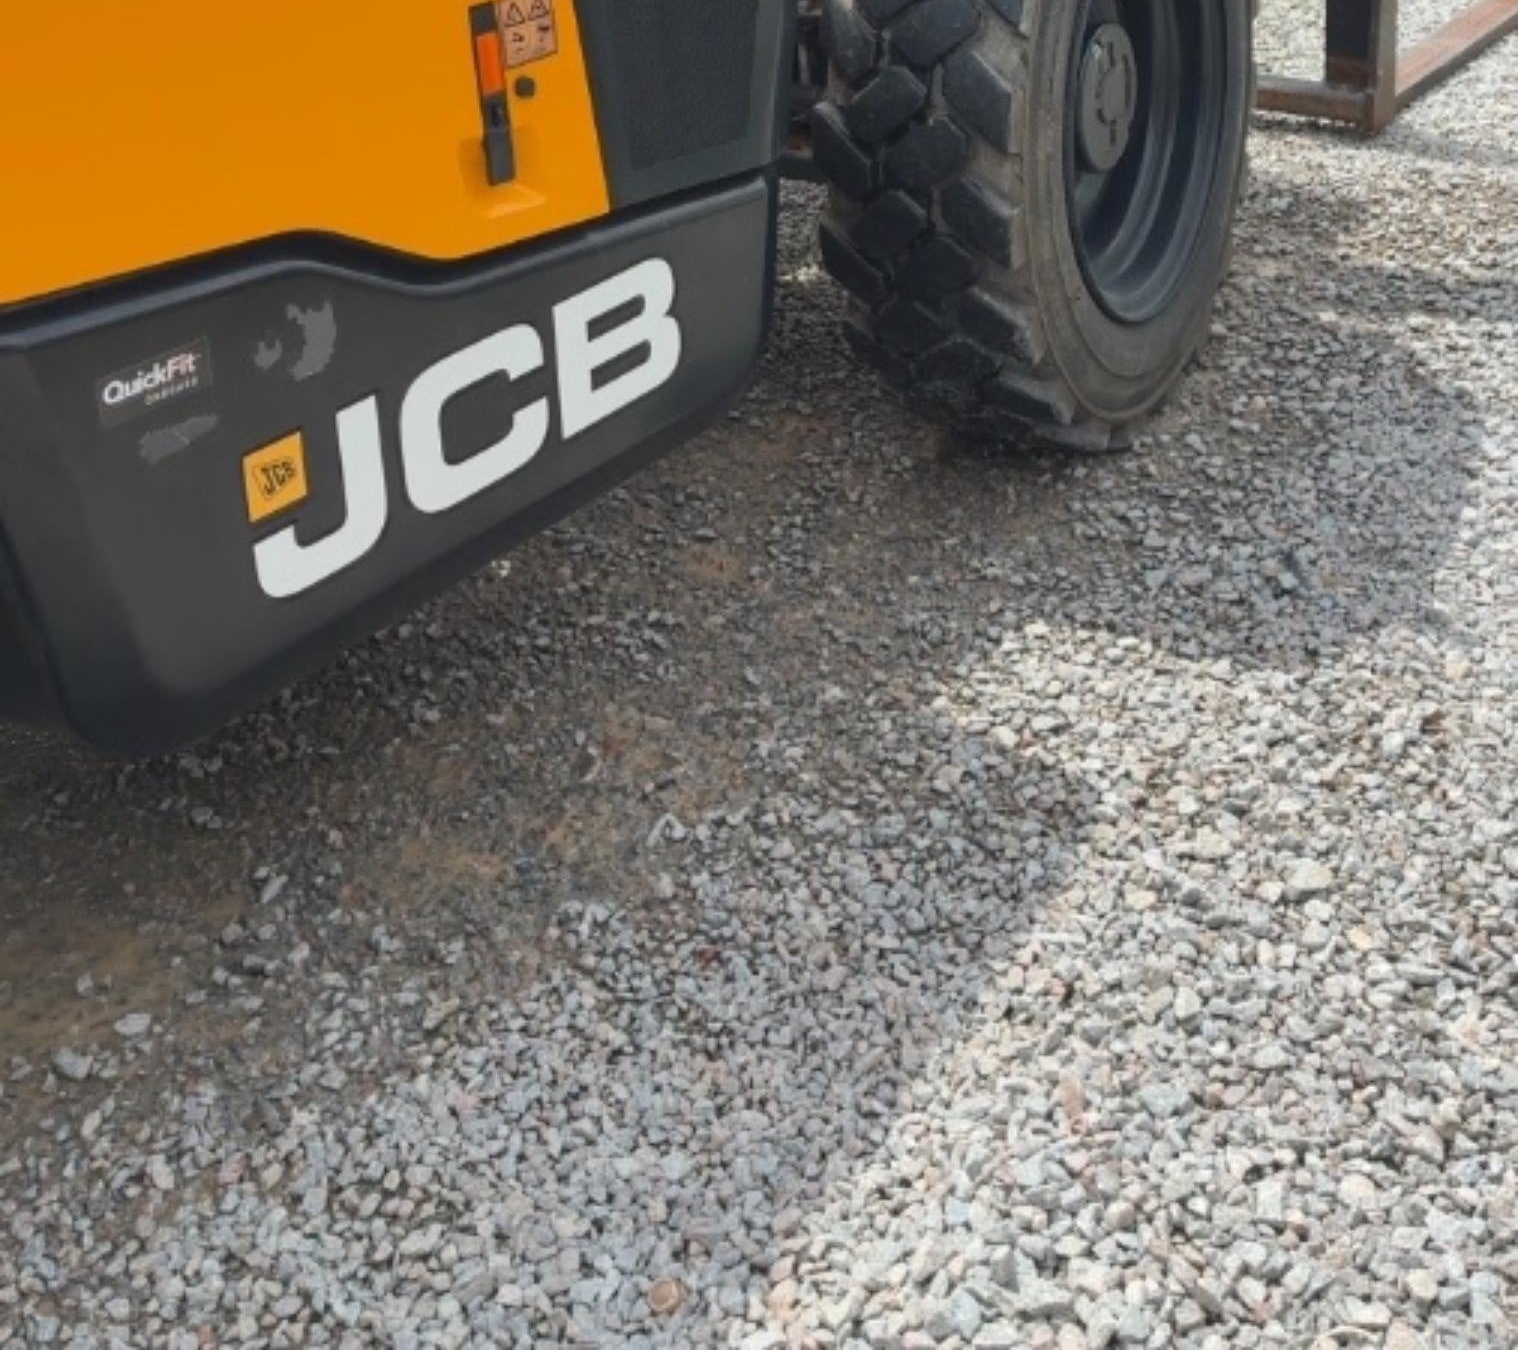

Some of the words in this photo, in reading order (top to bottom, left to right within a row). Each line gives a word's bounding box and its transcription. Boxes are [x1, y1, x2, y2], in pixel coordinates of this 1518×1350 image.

[103, 353, 197, 405] QuickFit
[253, 257, 682, 600] JCB
[259, 460, 294, 496] JCB
